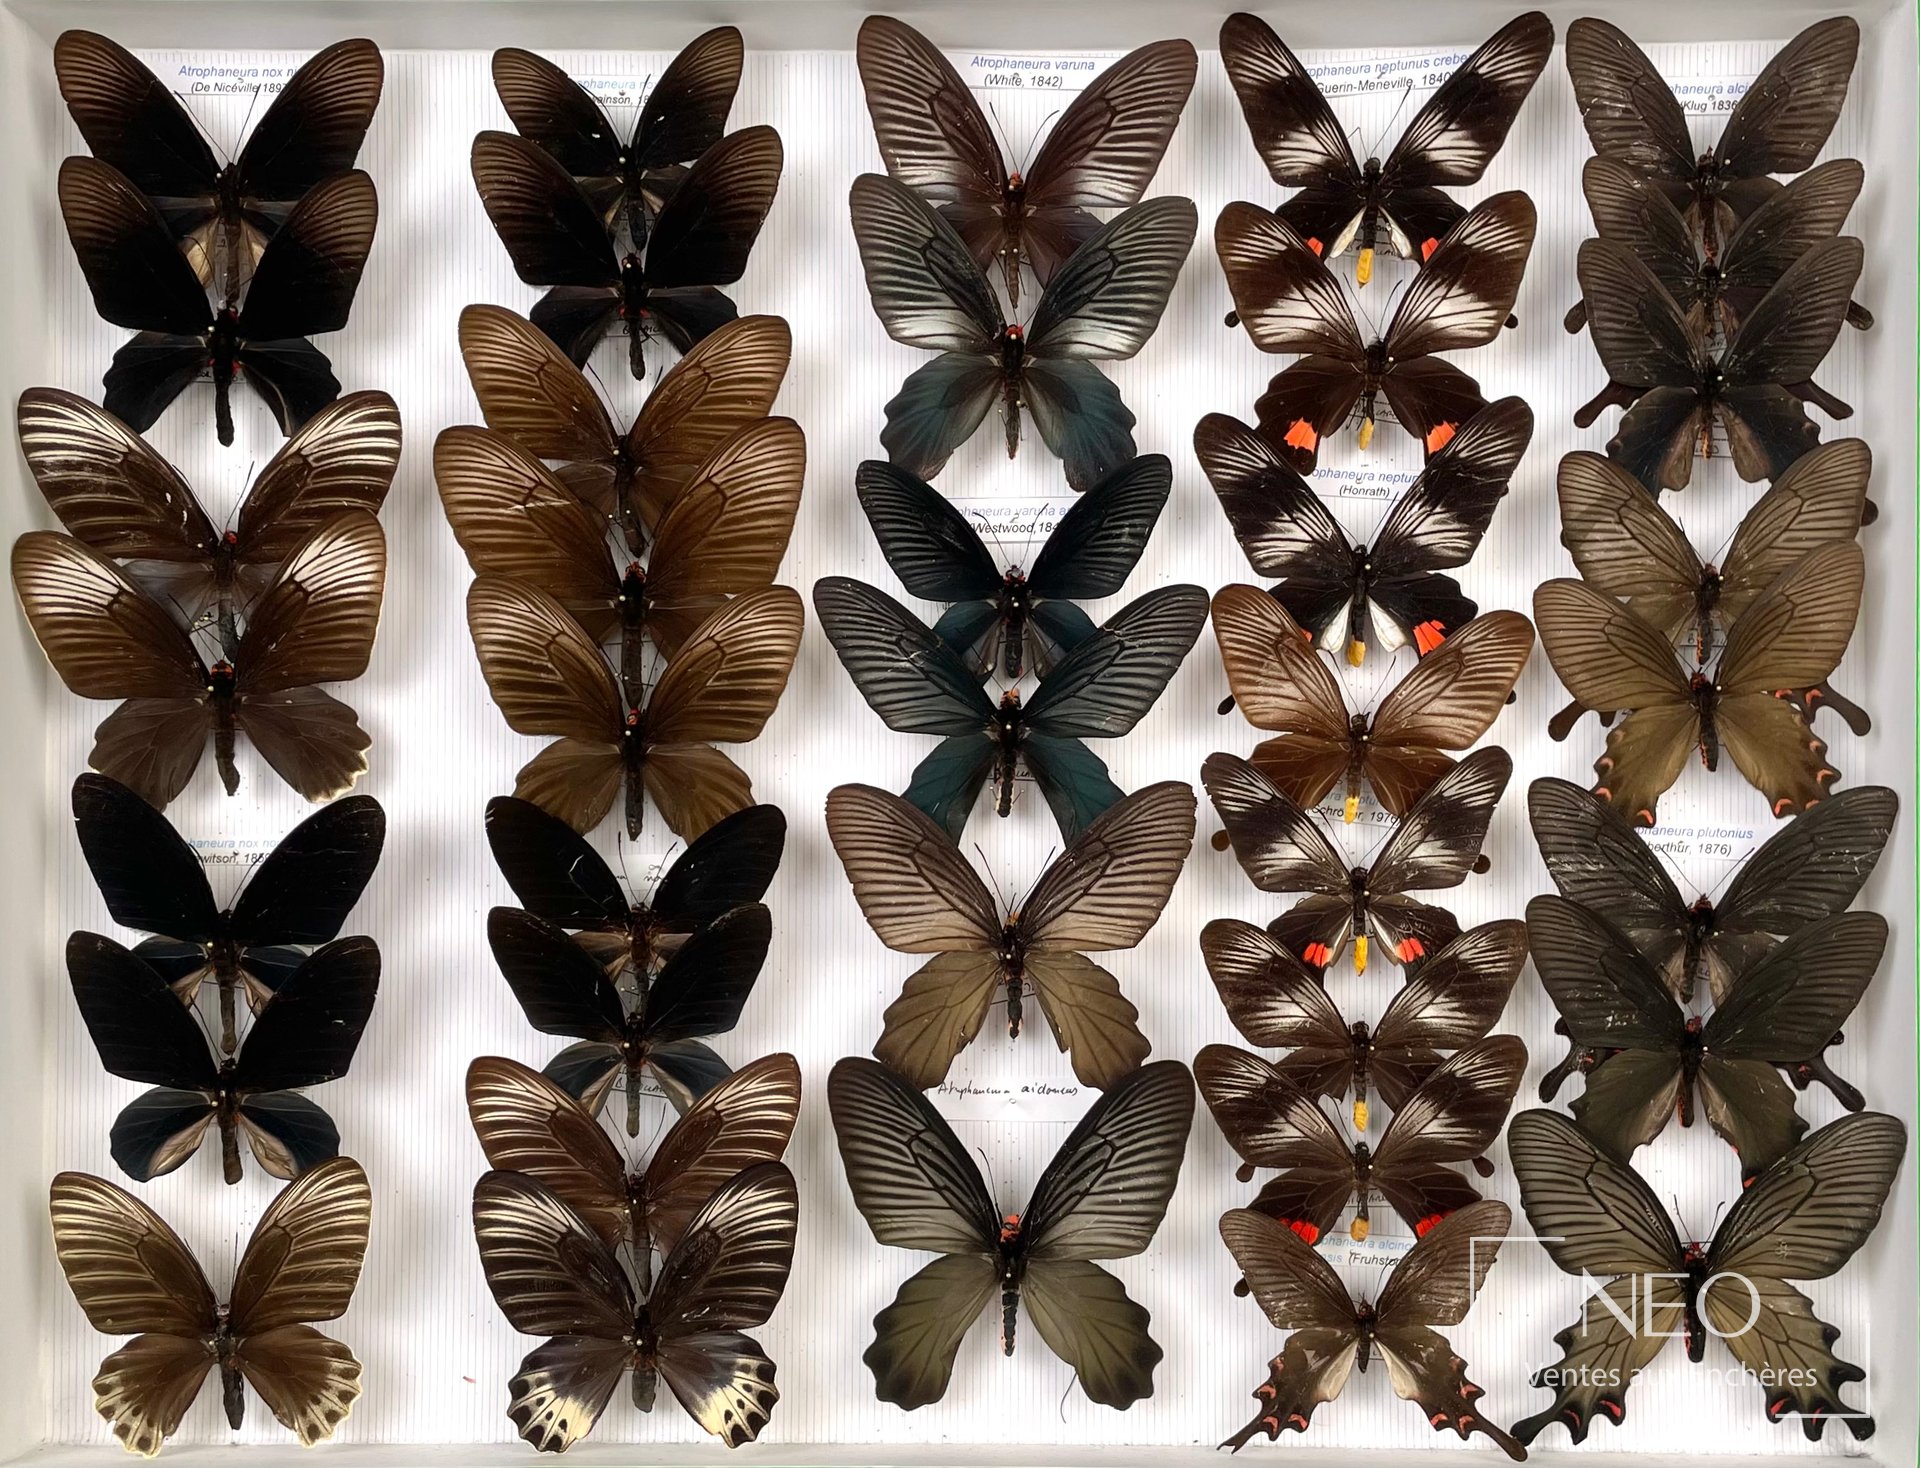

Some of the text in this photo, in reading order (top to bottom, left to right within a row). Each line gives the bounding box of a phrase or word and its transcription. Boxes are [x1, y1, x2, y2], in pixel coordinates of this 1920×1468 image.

[971, 56, 1095, 70] Atrophaneura varuna
[1306, 65, 1371, 79] rophaneura
[1375, 60, 1430, 76] neptunus
[178, 65, 259, 79] Atrophaneura
[262, 68, 283, 77] nox
[191, 81, 211, 94] (De
[984, 74, 1063, 89] (White, 1842)
[1316, 77, 1417, 94] Guerin-Meneville,
[1727, 82, 1751, 95] alci
[1311, 467, 1419, 485] ophaneura neptun
[1339, 484, 1391, 499] (Honrath)
[1015, 507, 1056, 517] varuna
[1038, 521, 1061, 533] 184
[1637, 826, 1754, 840] phaneura plutonius
[189, 837, 236, 848] haneura
[239, 840, 258, 848] nox
[1698, 843, 1732, 857] 1876)
[200, 853, 240, 865] witson,
[1321, 1235, 1412, 1251] phaneura alcino
